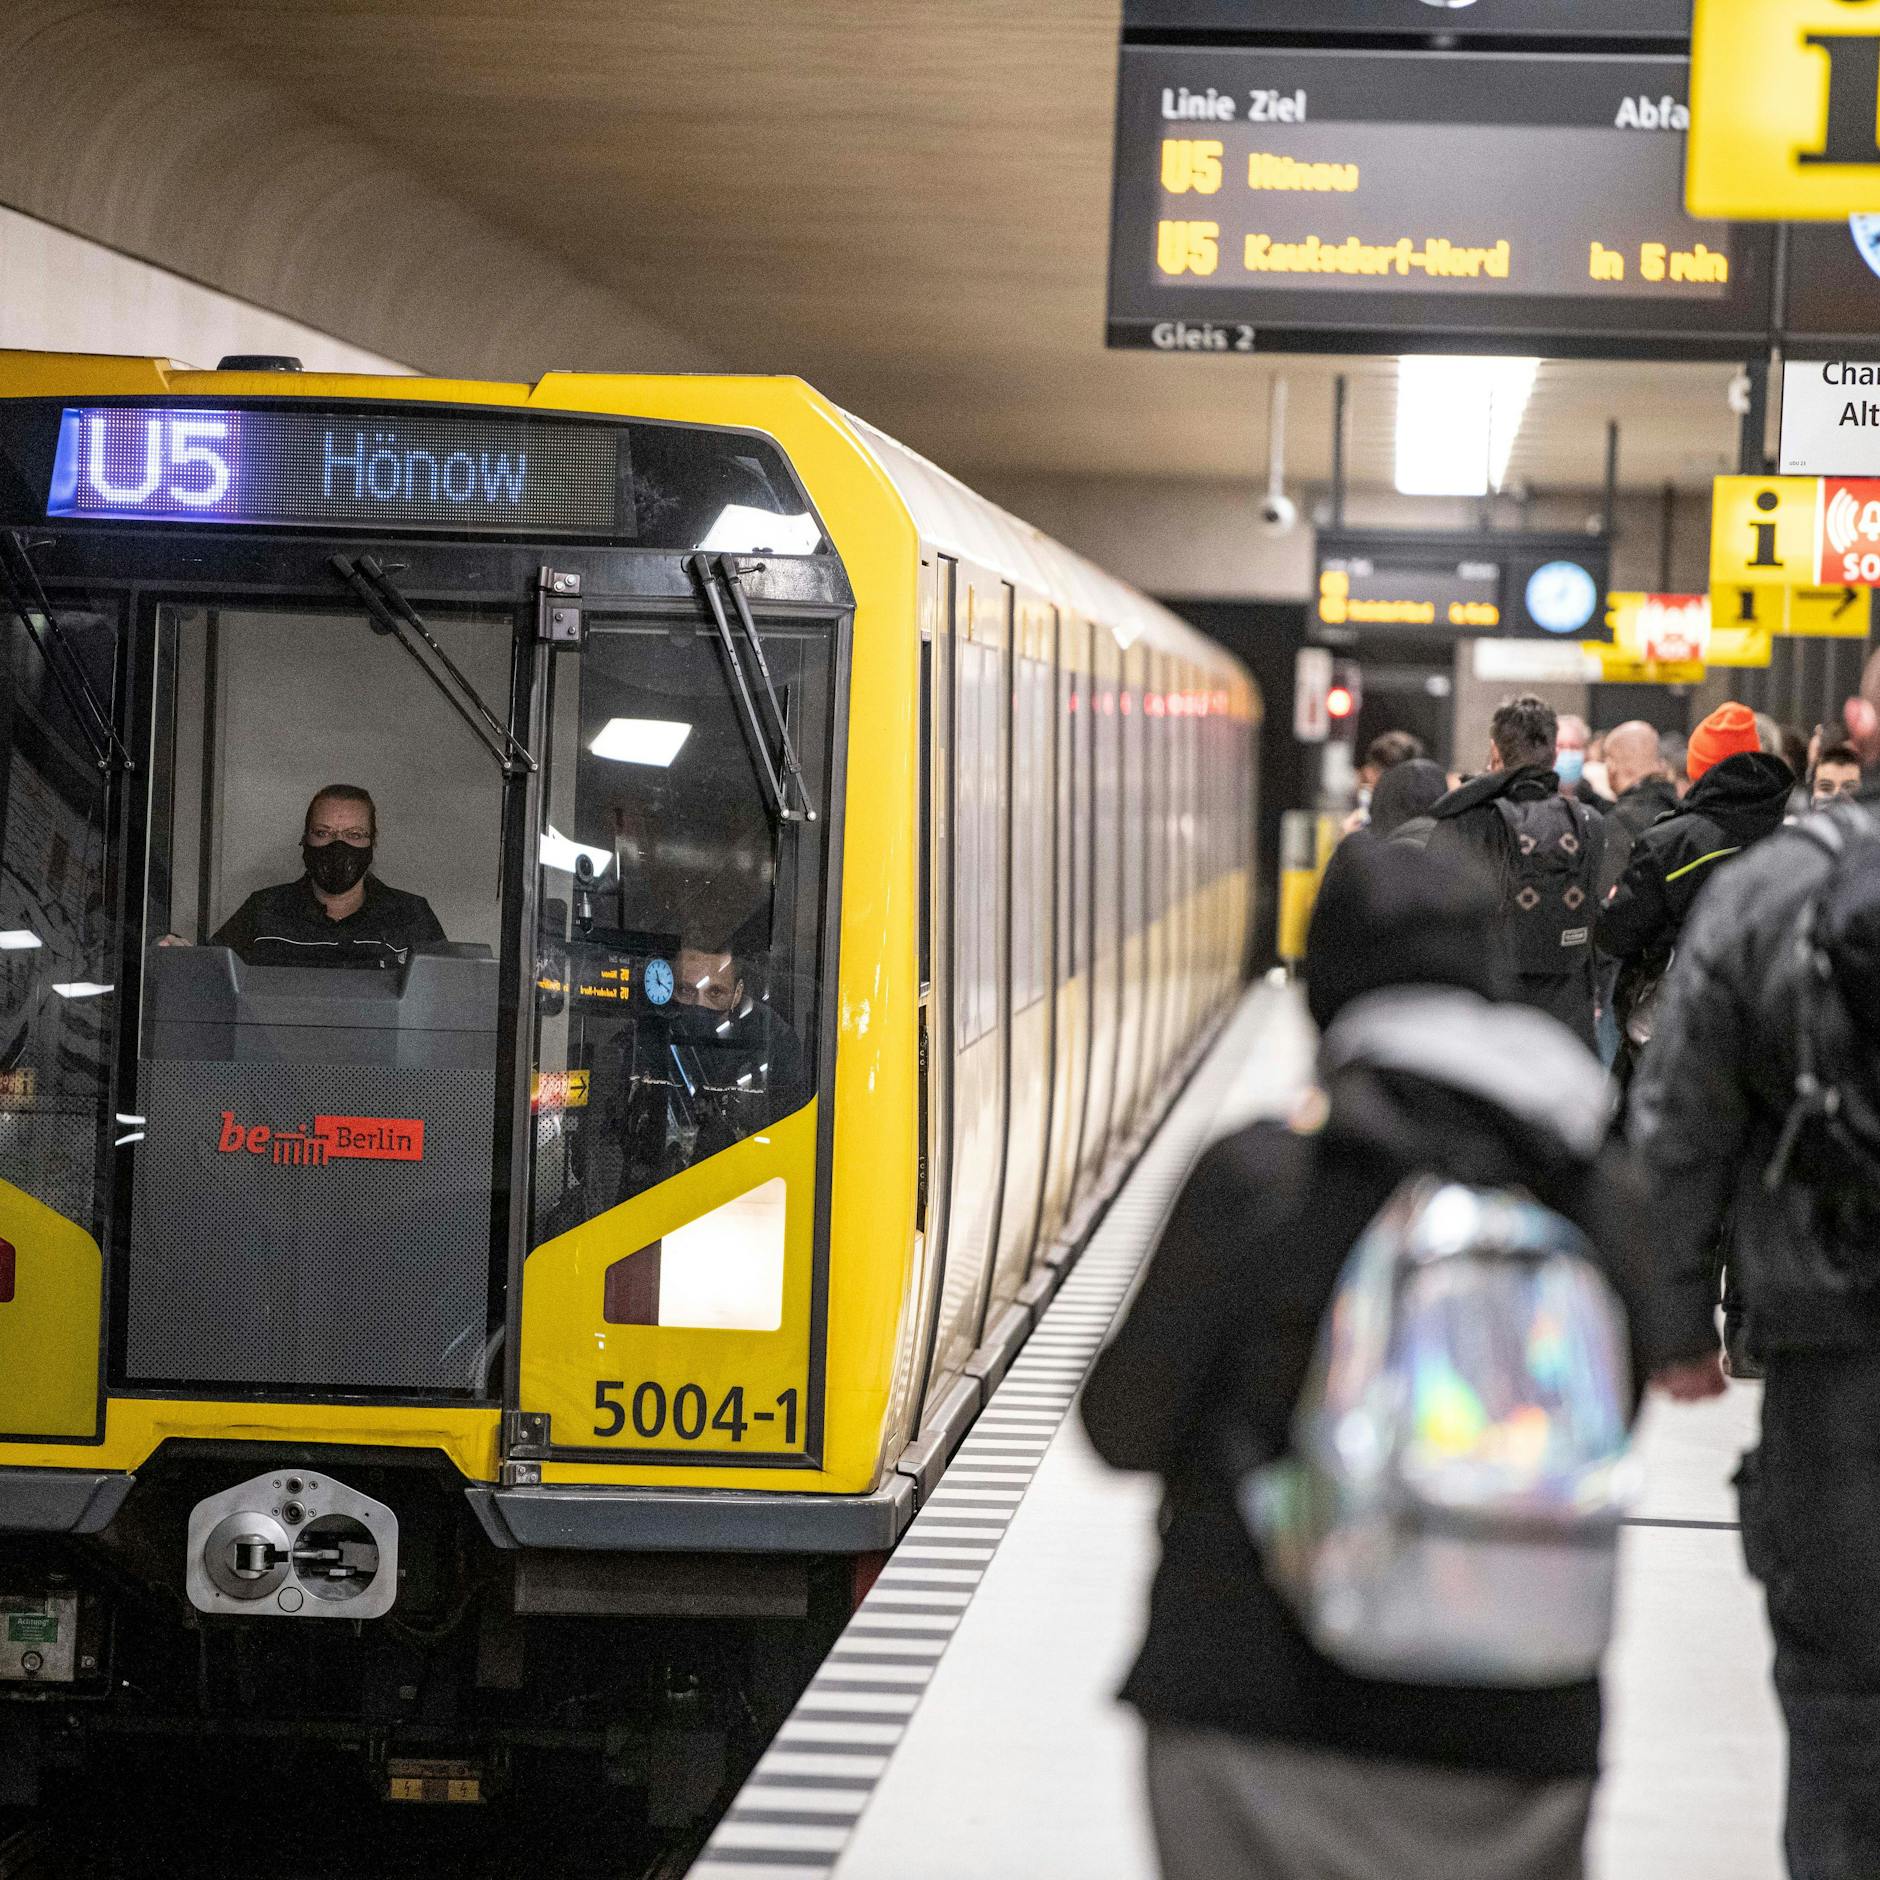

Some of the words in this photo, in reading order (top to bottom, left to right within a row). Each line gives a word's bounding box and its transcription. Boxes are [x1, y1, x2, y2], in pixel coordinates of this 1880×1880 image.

[1162, 87, 1236, 121] Linie
[1248, 88, 1307, 122] Ziel
[1161, 139, 1223, 194] U5
[1157, 220, 1219, 275] U5
[1590, 241, 1624, 280] in
[1151, 322, 1229, 350] Gleis
[1235, 324, 1255, 352] 2
[1838, 400, 1880, 428] Alt
[89, 418, 231, 505] U5
[323, 429, 527, 504] Hönow
[336, 1126, 412, 1152] Berlin
[593, 1380, 798, 1444] 5004-1
